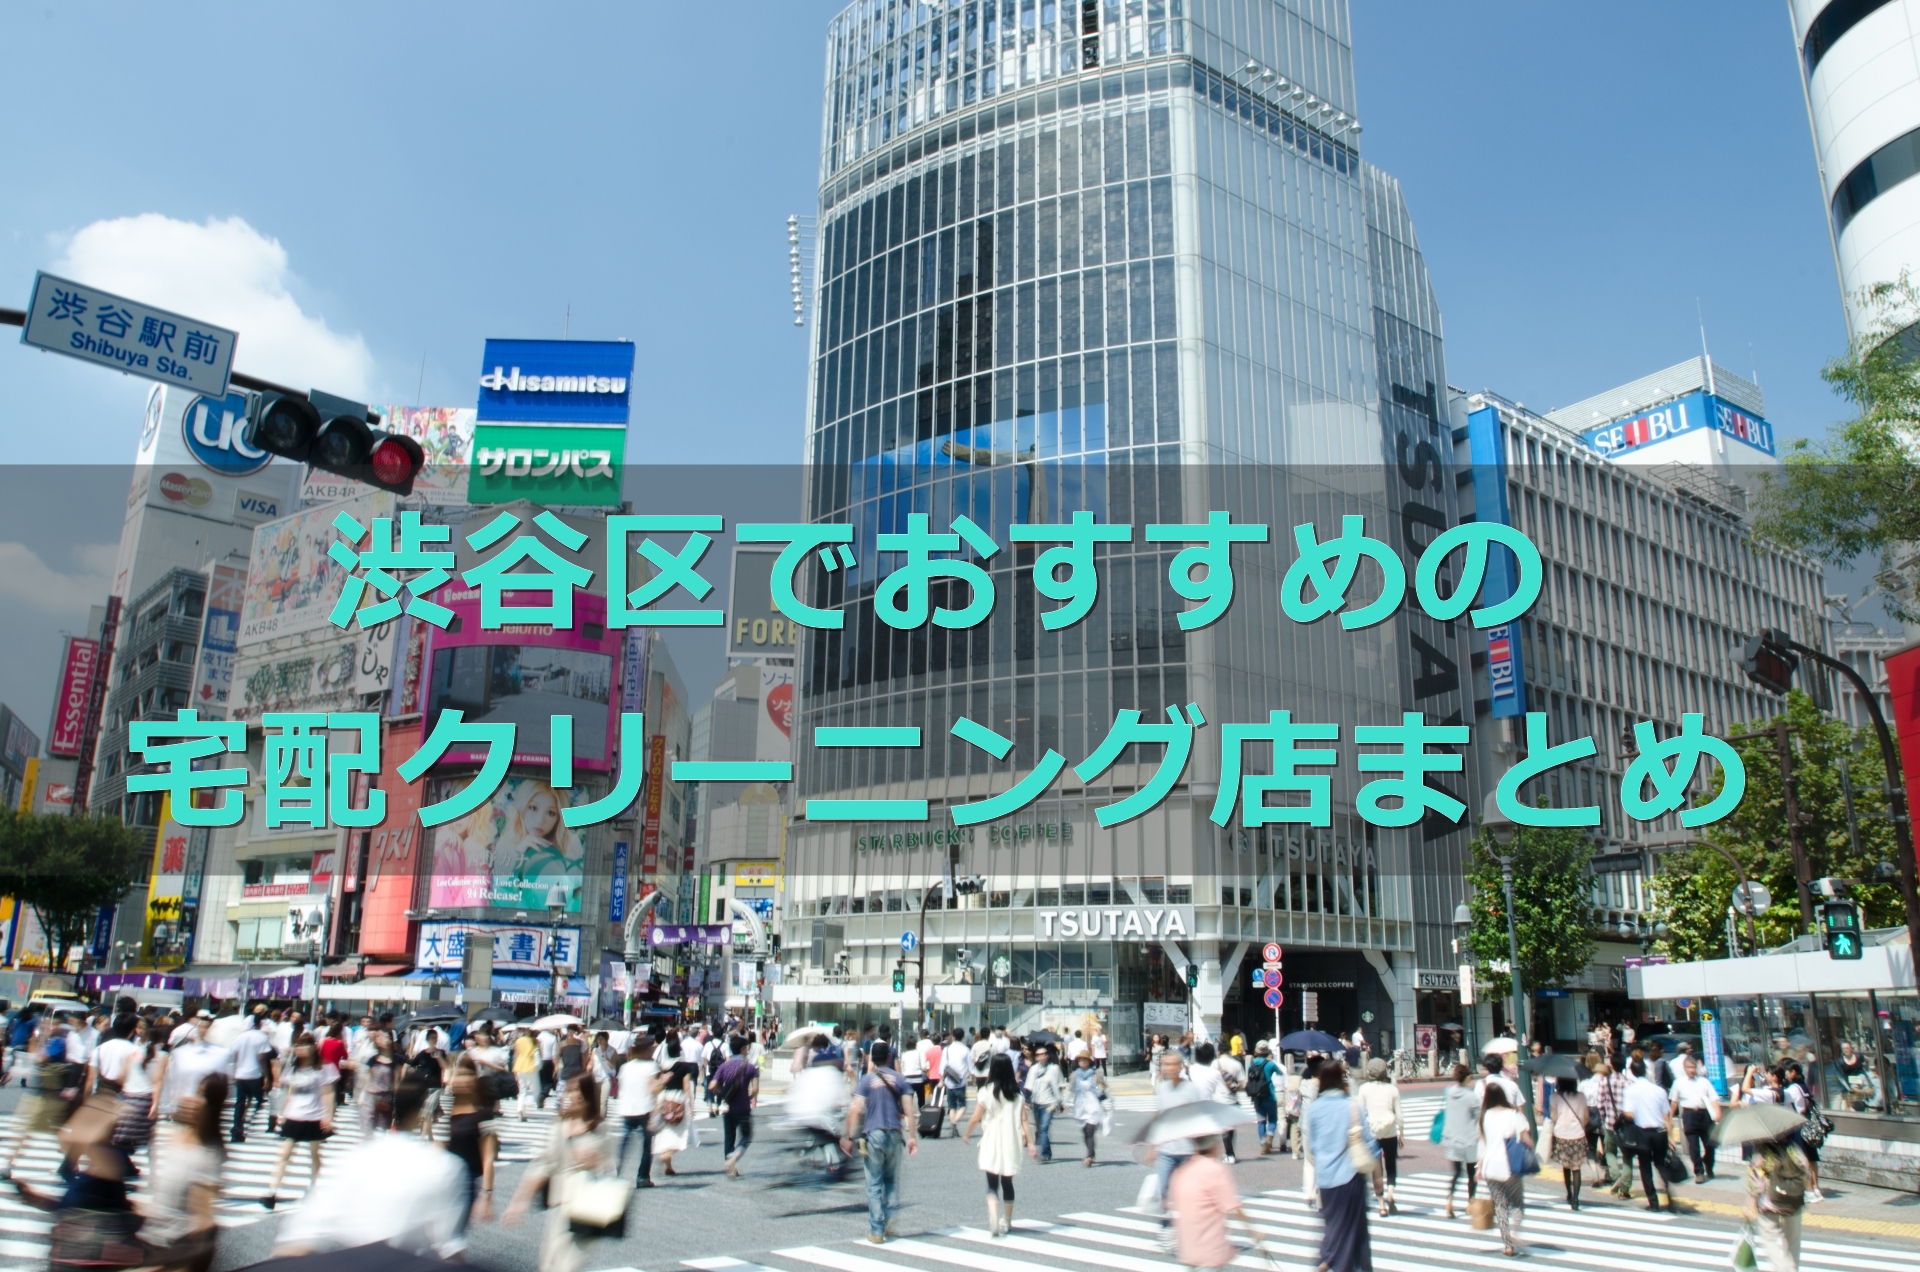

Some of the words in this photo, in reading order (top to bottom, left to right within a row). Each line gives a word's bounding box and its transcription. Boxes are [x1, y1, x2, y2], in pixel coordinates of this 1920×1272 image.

[47, 288, 220, 365] 渋谷駅前
[70, 331, 149, 367] Shibuya
[156, 355, 193, 381] Sta.
[479, 366, 627, 393] Hisamitsu
[1594, 403, 1690, 458] SEIBU
[1716, 403, 1771, 451] SEIBU
[476, 447, 613, 479] サロンパス
[160, 479, 212, 497] MasterCard
[240, 498, 277, 517] VISA
[244, 618, 278, 638] AKB48
[54, 640, 93, 750] Essential
[522, 755, 550, 763] CHANNEL
[649, 737, 664, 813] クスリのことなら
[370, 810, 418, 892] クスリ
[644, 819, 659, 866] 三千里
[858, 828, 974, 852] STARBUCKS
[988, 822, 1073, 843] COFFEE
[1271, 834, 1377, 869] TSUTAYA
[479, 888, 523, 902] Release!
[496, 878, 513, 888] Love
[513, 879, 549, 890] Collection
[612, 847, 626, 918] 大盛堂商事ビル
[1039, 909, 1187, 937] TSUTAYA
[424, 931, 571, 962] 大盛書店
[1420, 974, 1458, 986] TSUTAYA
